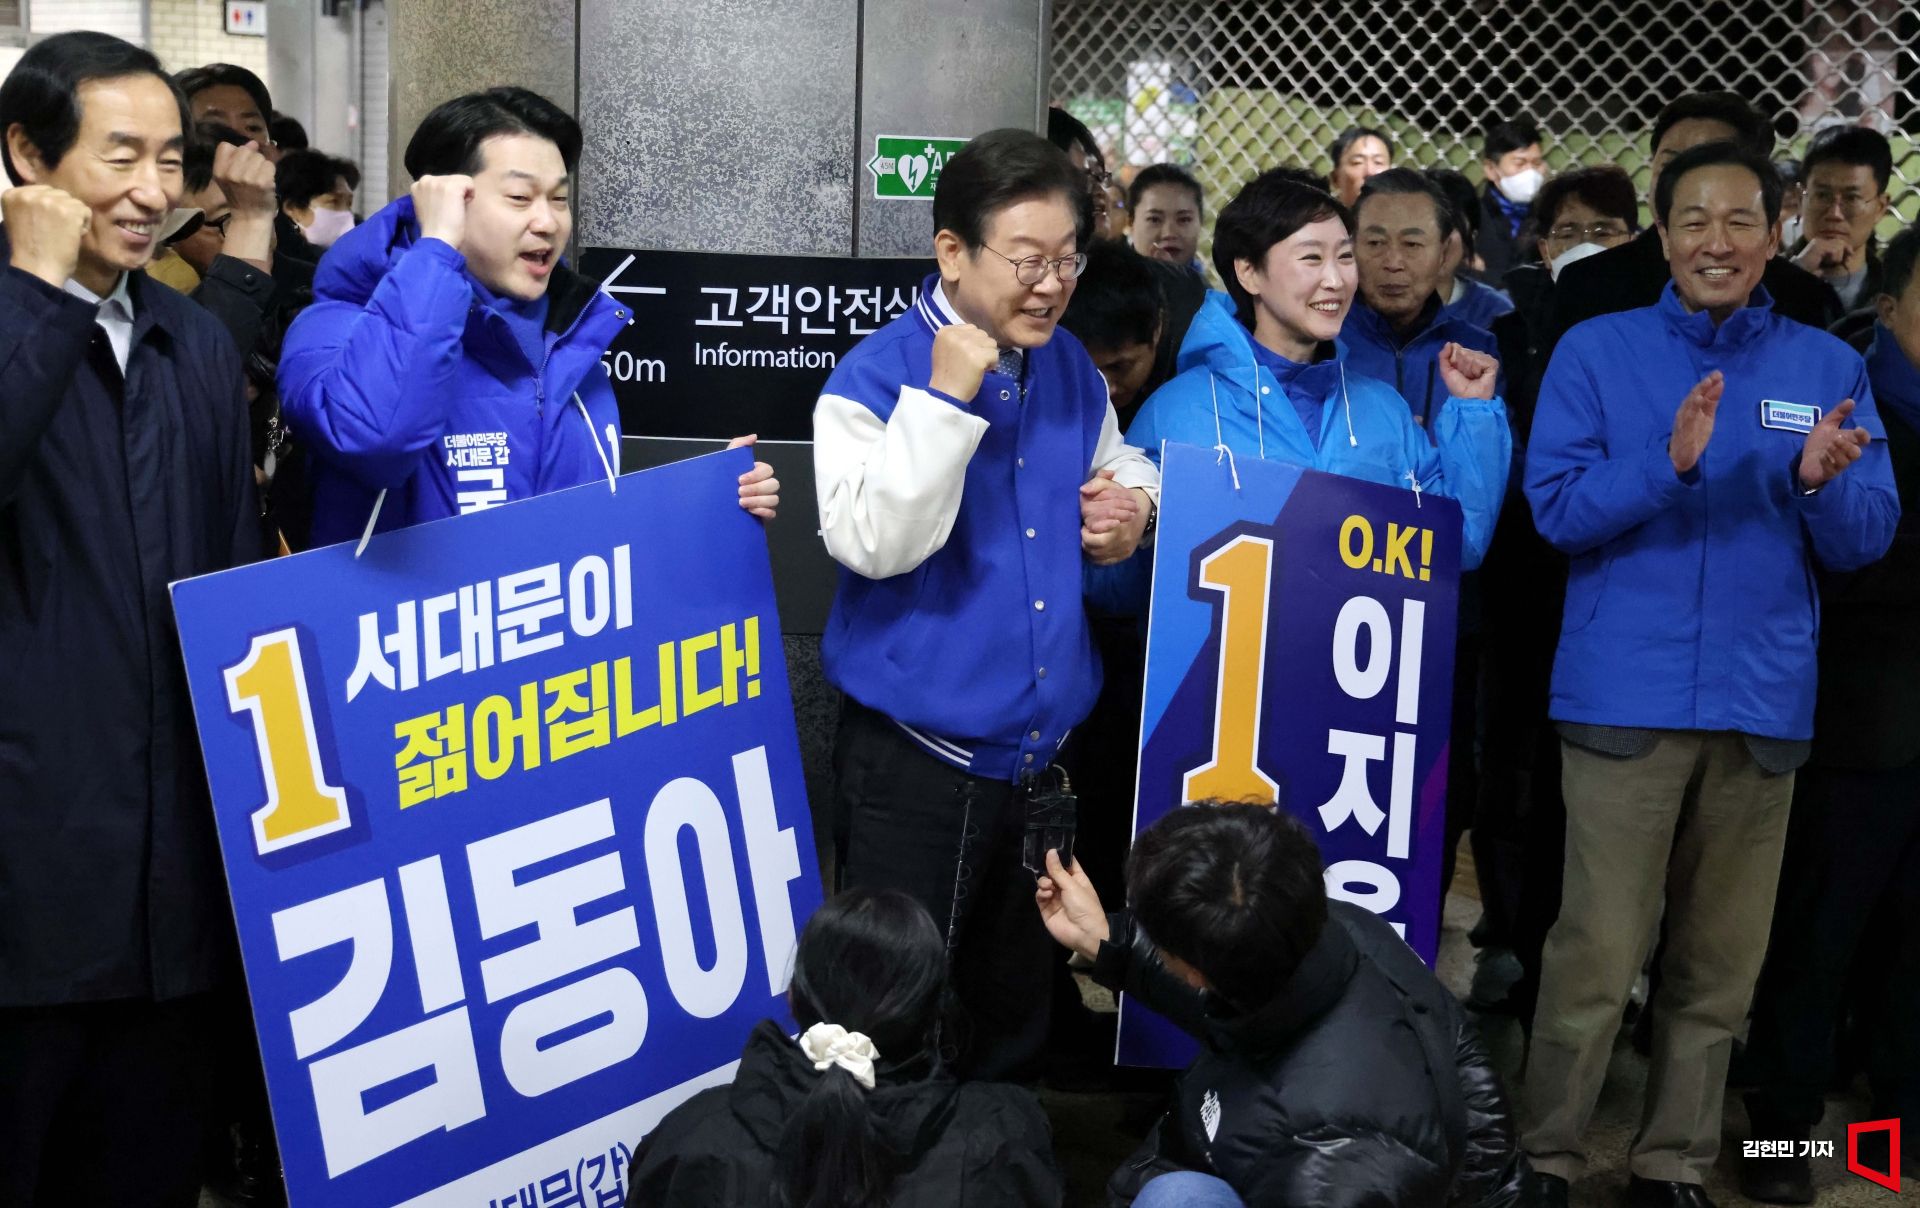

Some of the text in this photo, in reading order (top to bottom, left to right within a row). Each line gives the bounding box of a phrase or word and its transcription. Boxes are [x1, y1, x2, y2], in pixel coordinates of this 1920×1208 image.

[930, 151, 956, 175] A
[695, 342, 836, 370] Information
[443, 431, 508, 449] 더불어민주당
[446, 446, 511, 468] 서대문 갑
[1338, 514, 1434, 582] O.K!
[346, 544, 633, 703] 서대문이
[1181, 534, 1280, 808] 1
[223, 627, 352, 856] 1
[394, 615, 761, 810] 젊어집니다!
[271, 744, 802, 1180] 김동아
